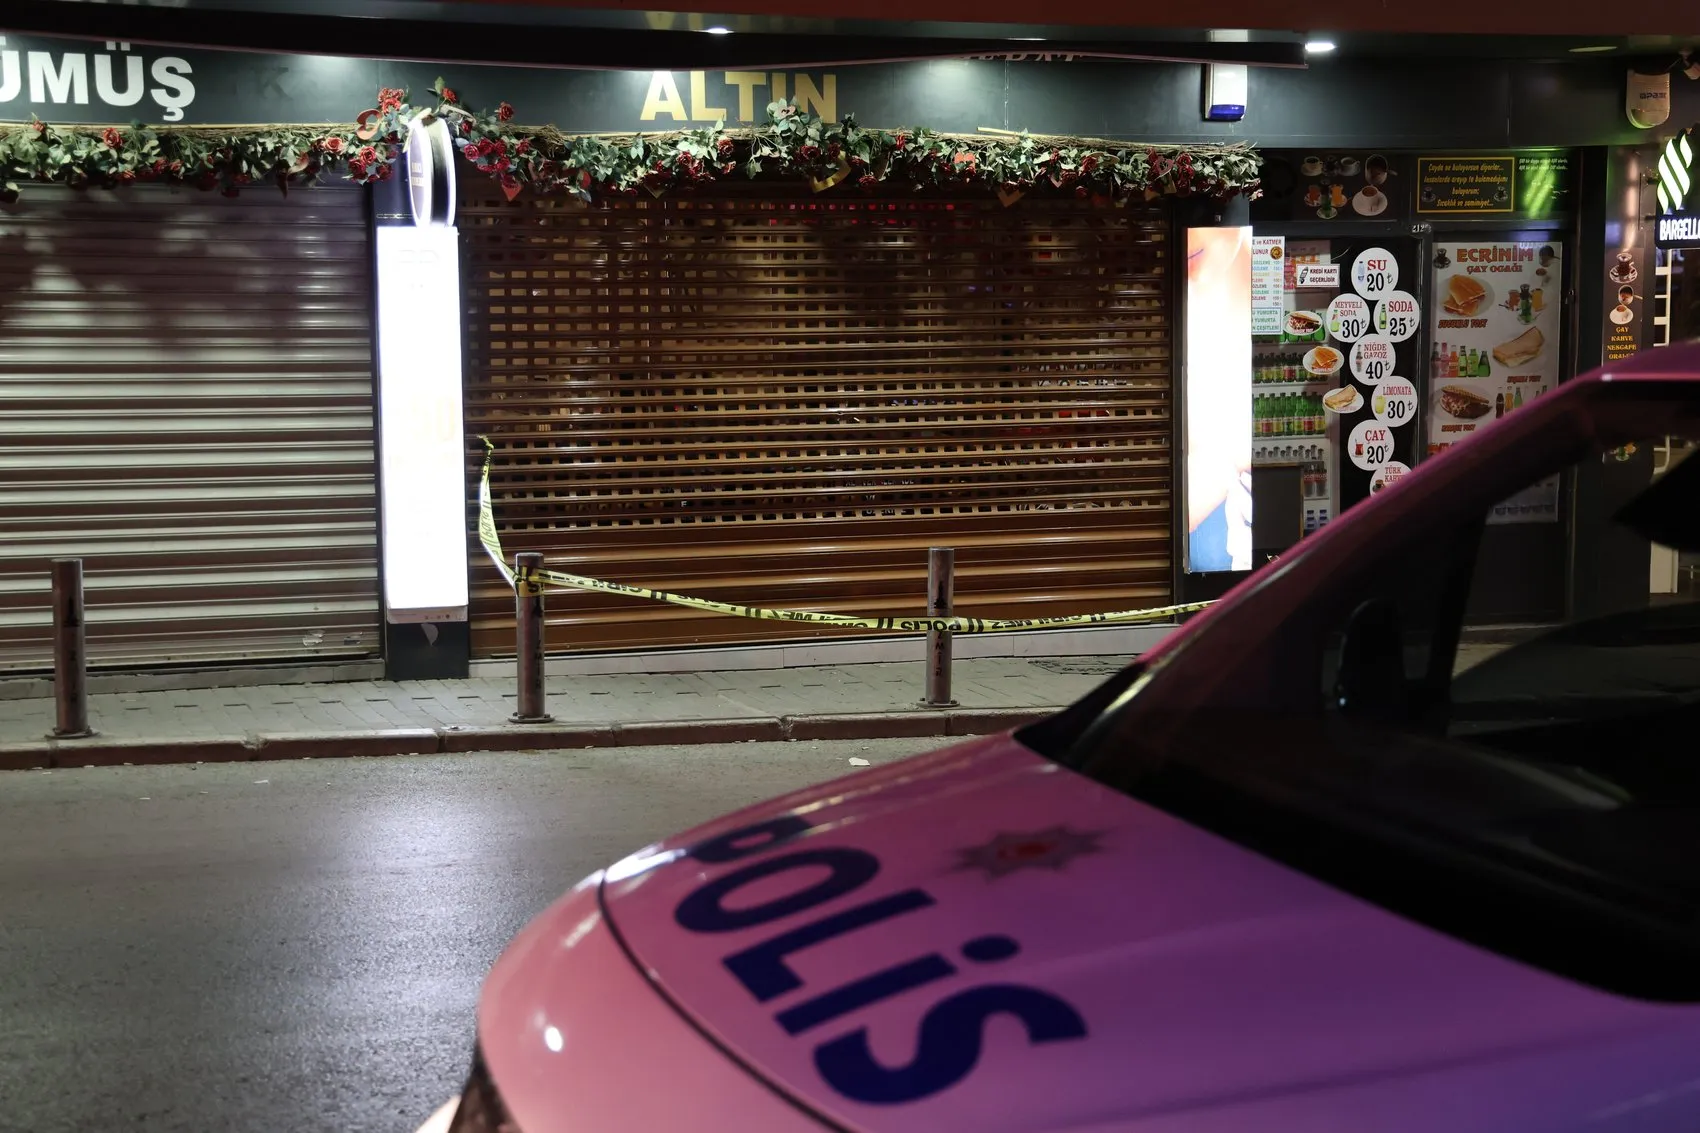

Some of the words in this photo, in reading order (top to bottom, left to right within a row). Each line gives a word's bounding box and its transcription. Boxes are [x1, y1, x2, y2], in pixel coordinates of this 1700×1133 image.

[640, 70, 837, 124] ALTIN
[1659, 217, 1700, 241] BARGELL
[1456, 245, 1533, 263] ECRİNİM
[1367, 260, 1387, 271] SU
[1367, 272, 1384, 292] 20
[1388, 301, 1413, 312] SODA
[1342, 319, 1360, 338] 30
[1389, 317, 1407, 336] 25
[1364, 342, 1387, 351] NİĞDE
[1364, 351, 1387, 359] GAZOZ
[1365, 361, 1383, 379] 40
[1383, 384, 1412, 395] LİMONATA
[1387, 400, 1405, 419] 30
[1365, 430, 1386, 444] ÇAY
[1367, 445, 1384, 464] 20
[1385, 465, 1401, 474] TÜRK
